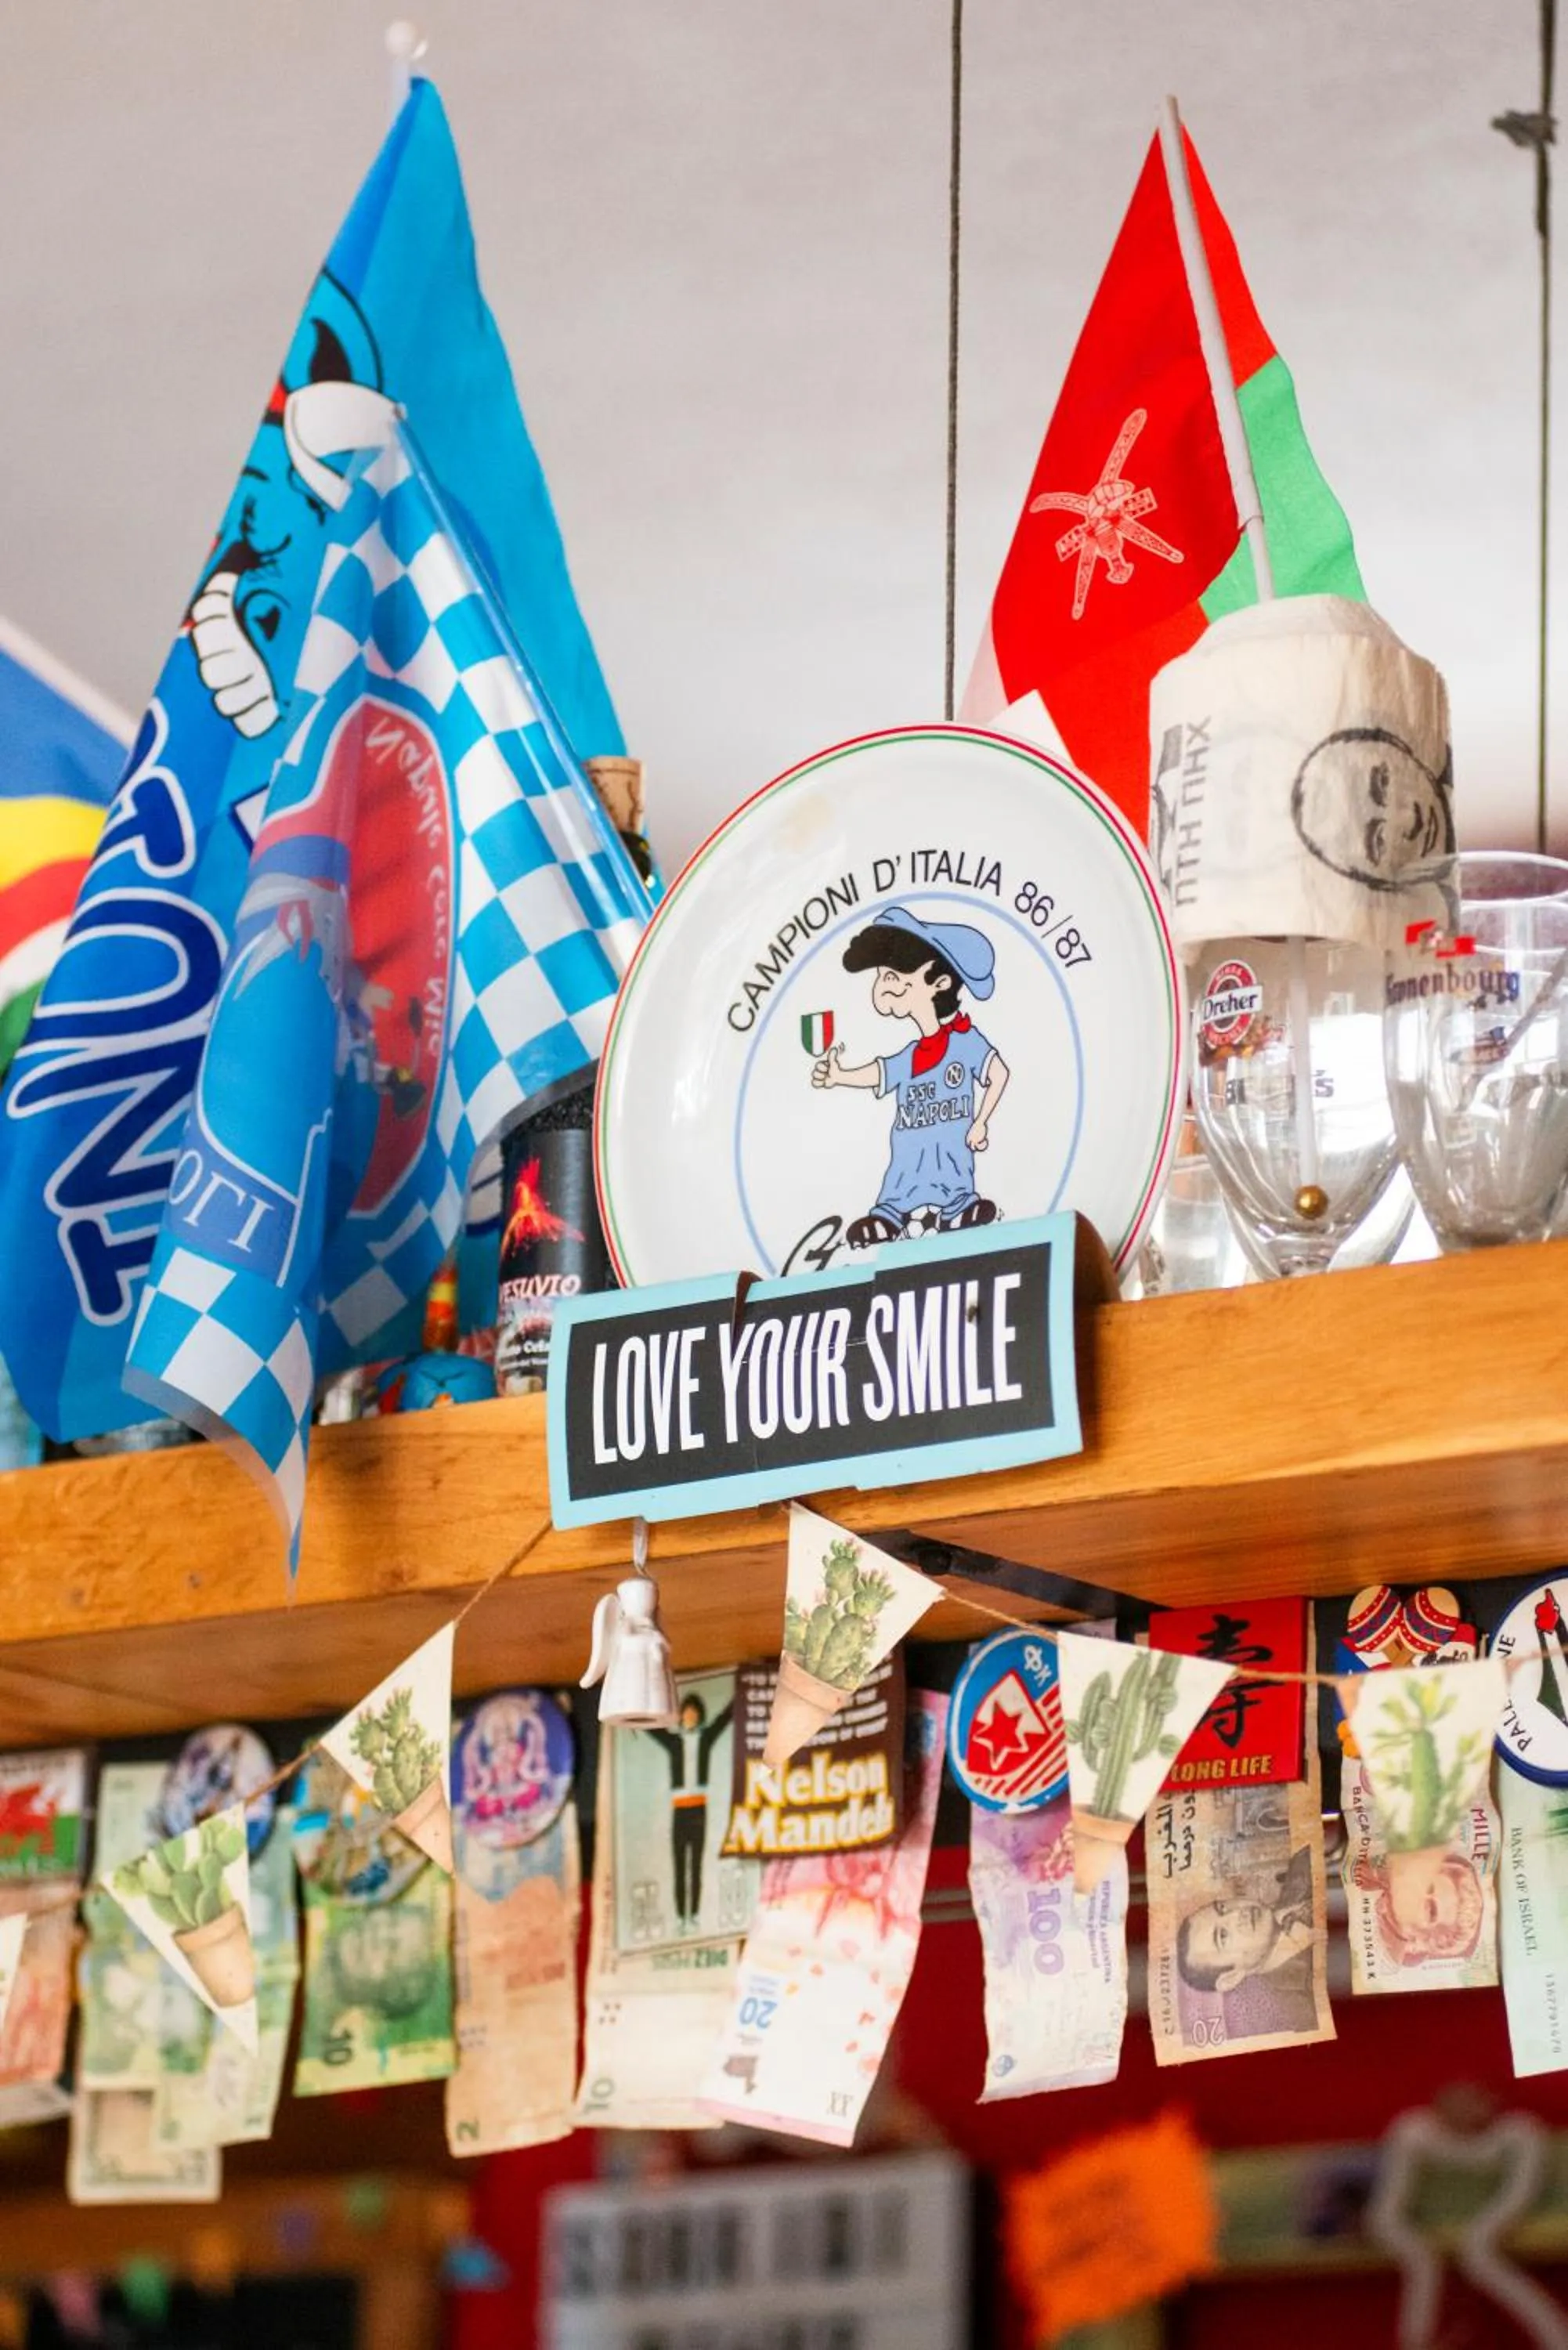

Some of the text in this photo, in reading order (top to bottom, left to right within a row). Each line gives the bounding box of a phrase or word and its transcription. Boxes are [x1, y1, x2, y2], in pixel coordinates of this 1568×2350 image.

[728, 850, 1092, 1035] CAMPIONI D'ITALIA 86/87
[1203, 991, 1258, 1020] Dreher
[897, 1095, 970, 1130] NAPOLI
[907, 1081, 936, 1103] SSC
[593, 1273, 1022, 1465] LOVE YOUR SMILE
[746, 1751, 889, 1809] Nelson
[1172, 1755, 1273, 1782] LONG LIFE
[1353, 1787, 1369, 1833] BANCA
[1470, 1808, 1490, 1861] MILLE
[1510, 1827, 1537, 1956] BANK OF ISRAEL
[1027, 1889, 1065, 1976] 100
[739, 1997, 777, 2030] 20
[1191, 2016, 1225, 2048] 20
[321, 2028, 354, 2068] 10
